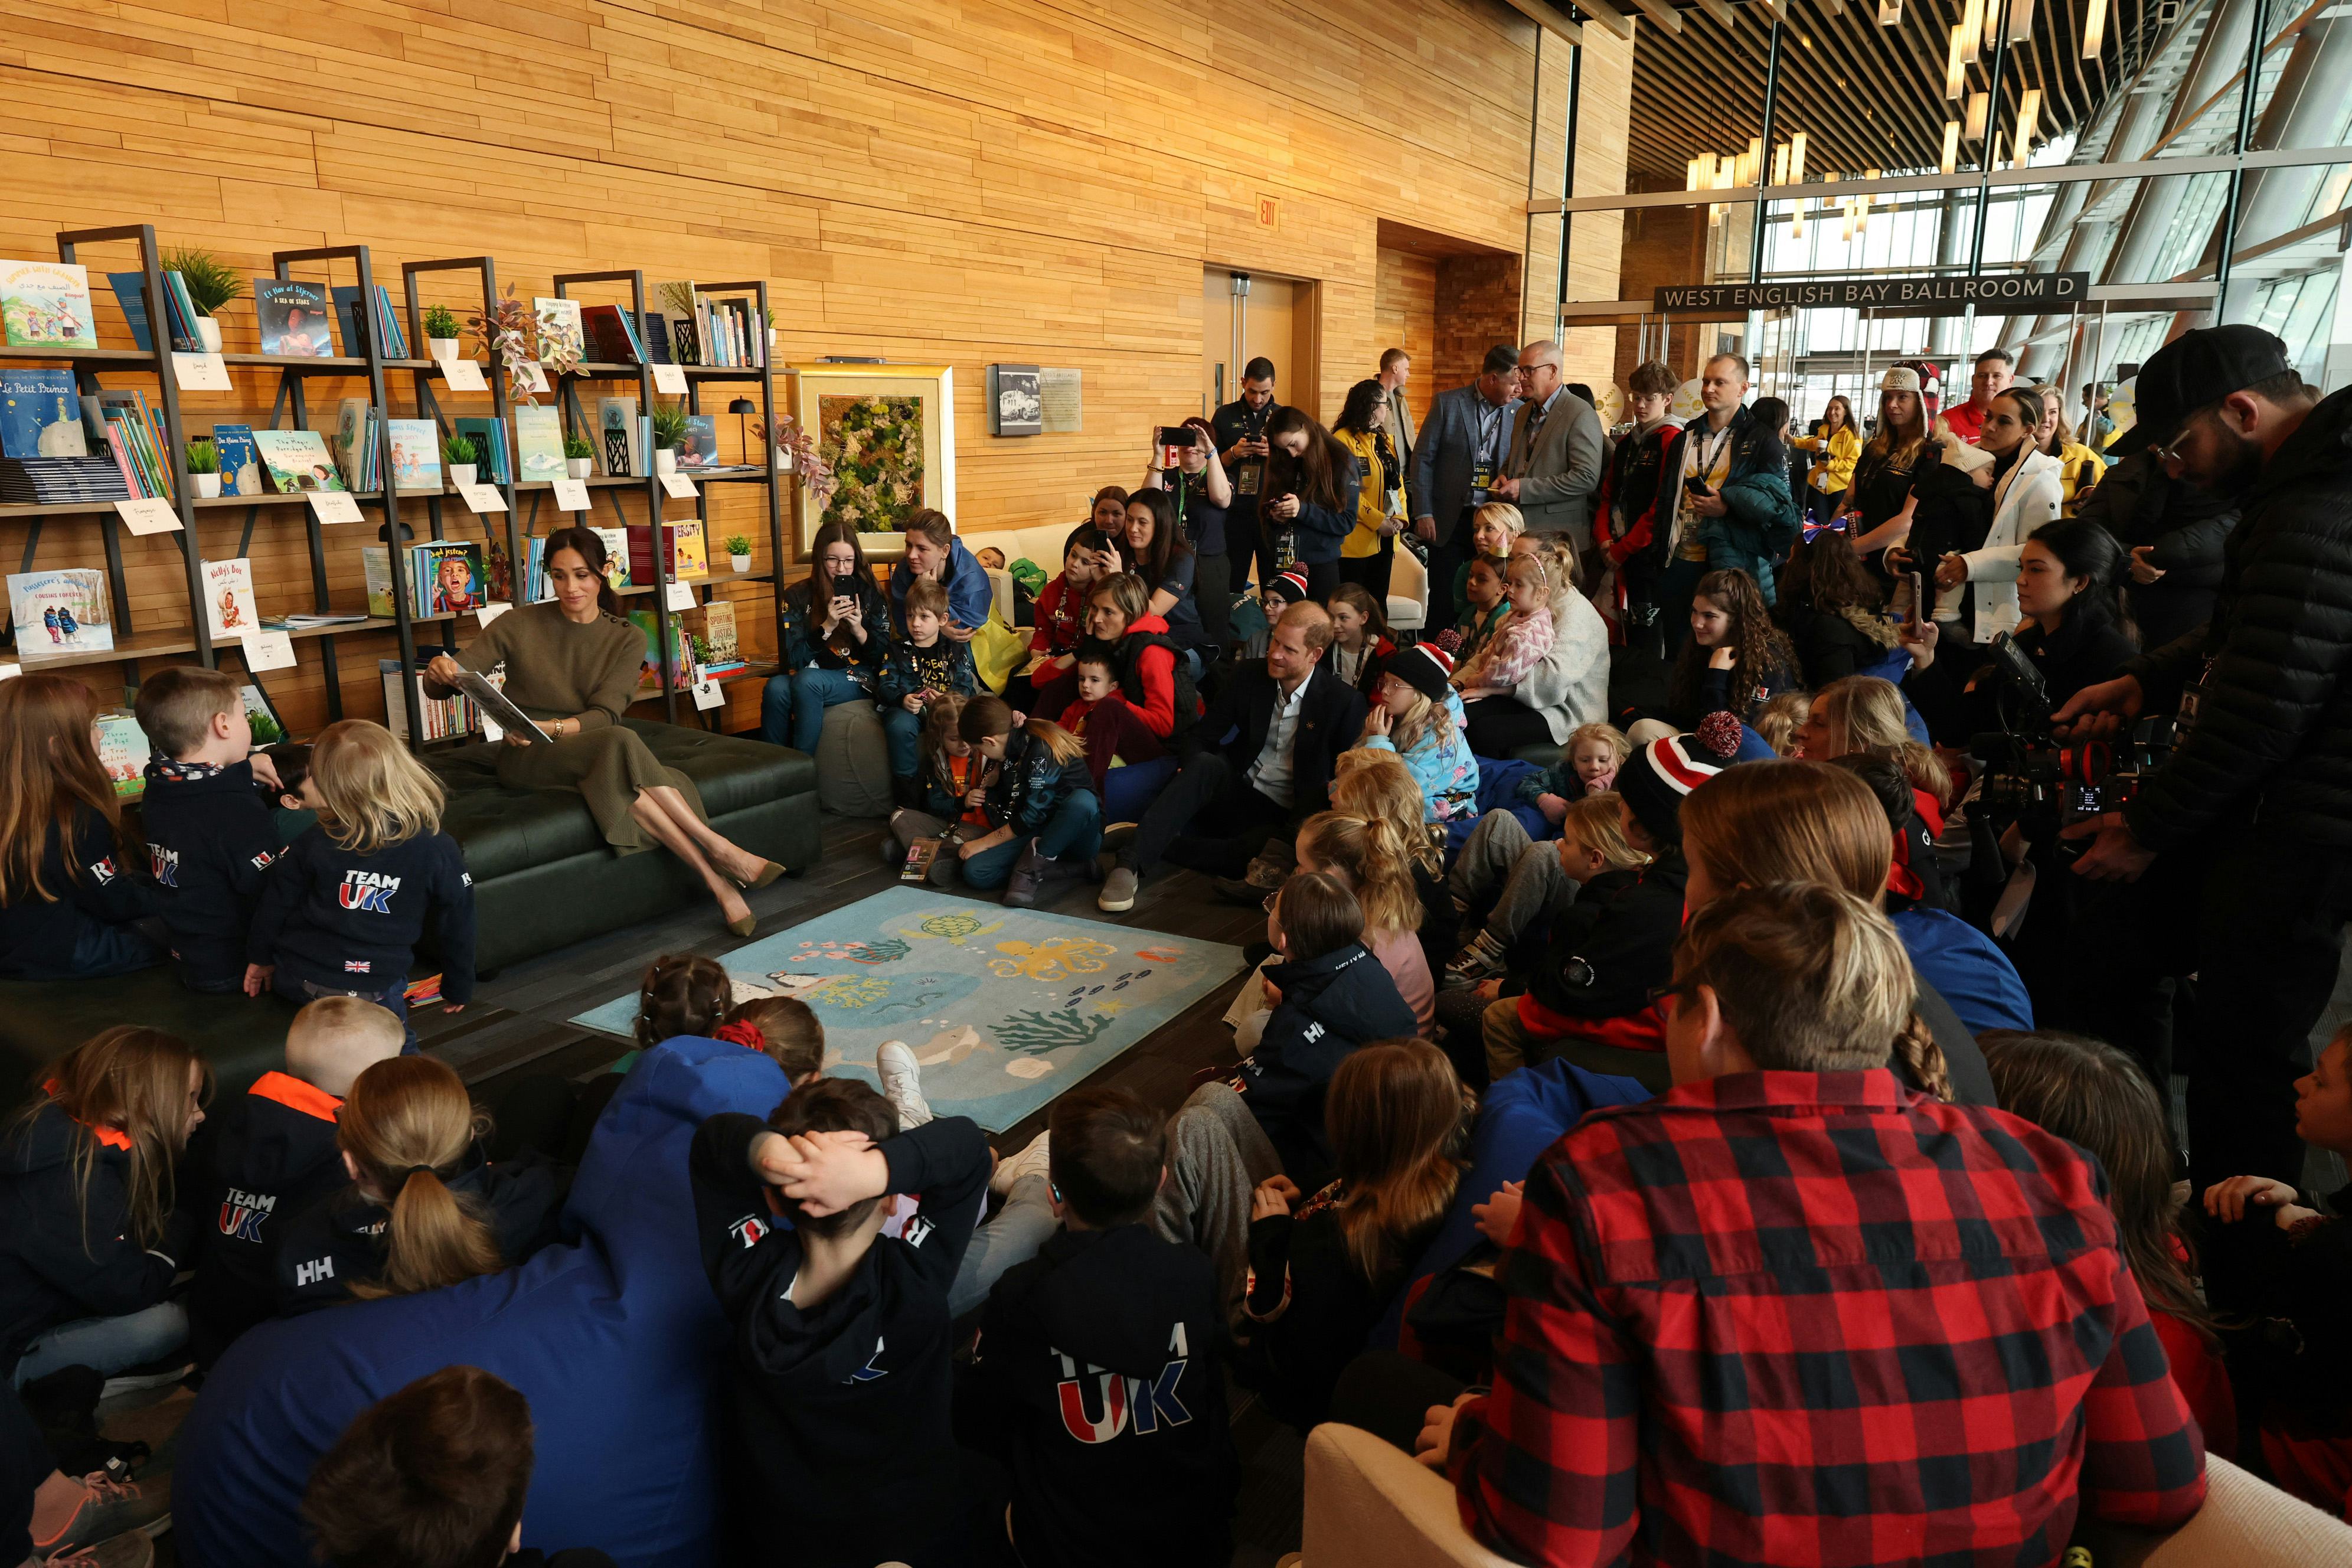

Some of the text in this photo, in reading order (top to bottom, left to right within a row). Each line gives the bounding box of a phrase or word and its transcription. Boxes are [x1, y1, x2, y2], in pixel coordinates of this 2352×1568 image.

[1261, 200, 1275, 226] EXIT
[1665, 277, 2074, 306] WEST ENGLISH BAY BALLROOM D
[2, 383, 69, 394] Le Petit Prince
[406, 424, 426, 435] Street
[694, 419, 709, 430] Stars
[118, 451, 131, 479] Allergique
[678, 524, 700, 538] ERSITY
[211, 564, 243, 579] Nelly's Box
[710, 613, 733, 625] SPORTING
[714, 627, 733, 639] JUSTICE
[146, 842, 178, 864] TEAM
[151, 853, 178, 888] UK
[346, 870, 401, 890] TEAM
[339, 883, 396, 914] UK
[228, 1187, 277, 1212] TEAM
[219, 1202, 270, 1243] UK
[296, 1256, 334, 1286] HH
[1057, 1359, 1193, 1444] UK
